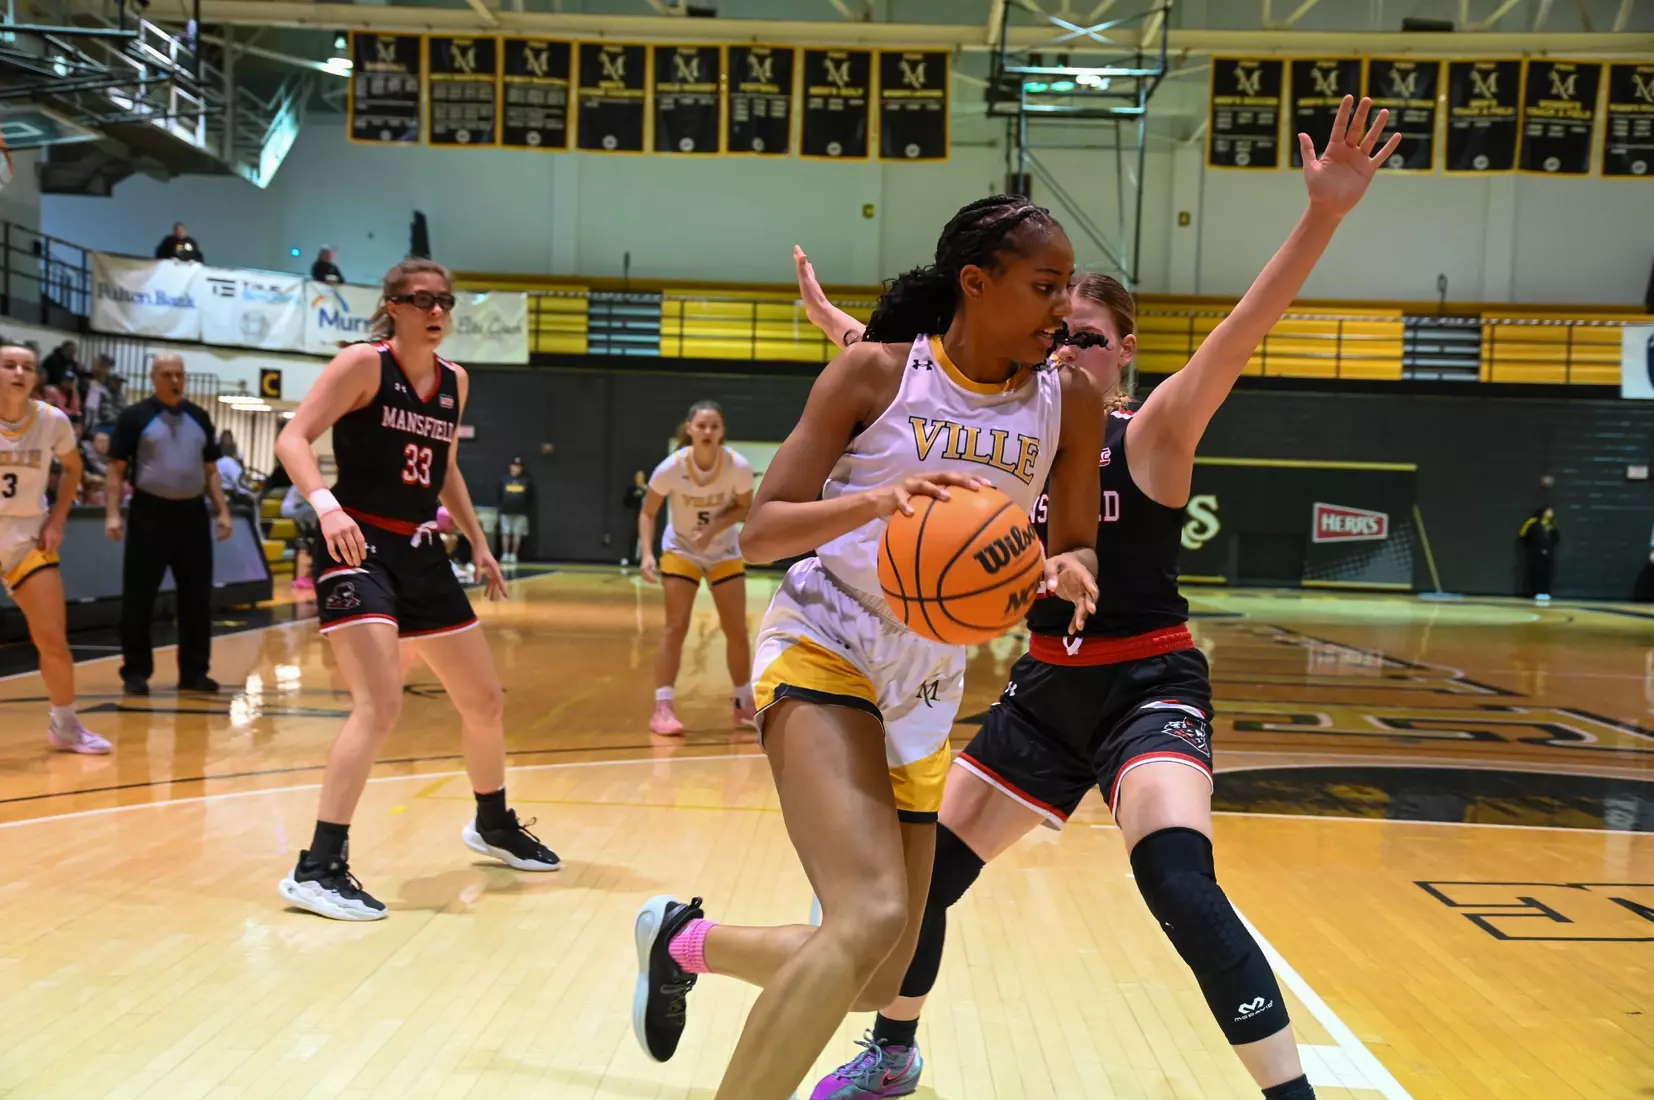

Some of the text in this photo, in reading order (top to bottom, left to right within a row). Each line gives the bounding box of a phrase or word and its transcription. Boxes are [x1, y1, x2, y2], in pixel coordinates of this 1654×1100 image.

[319, 308, 372, 333] Murr
[263, 372, 279, 396] C
[402, 443, 433, 488] 33
[909, 416, 1040, 485] VILLE
[2, 473, 18, 498] 3
[697, 511, 710, 526] 5
[973, 525, 1037, 574] Wilso
[1004, 574, 1041, 614] NC
